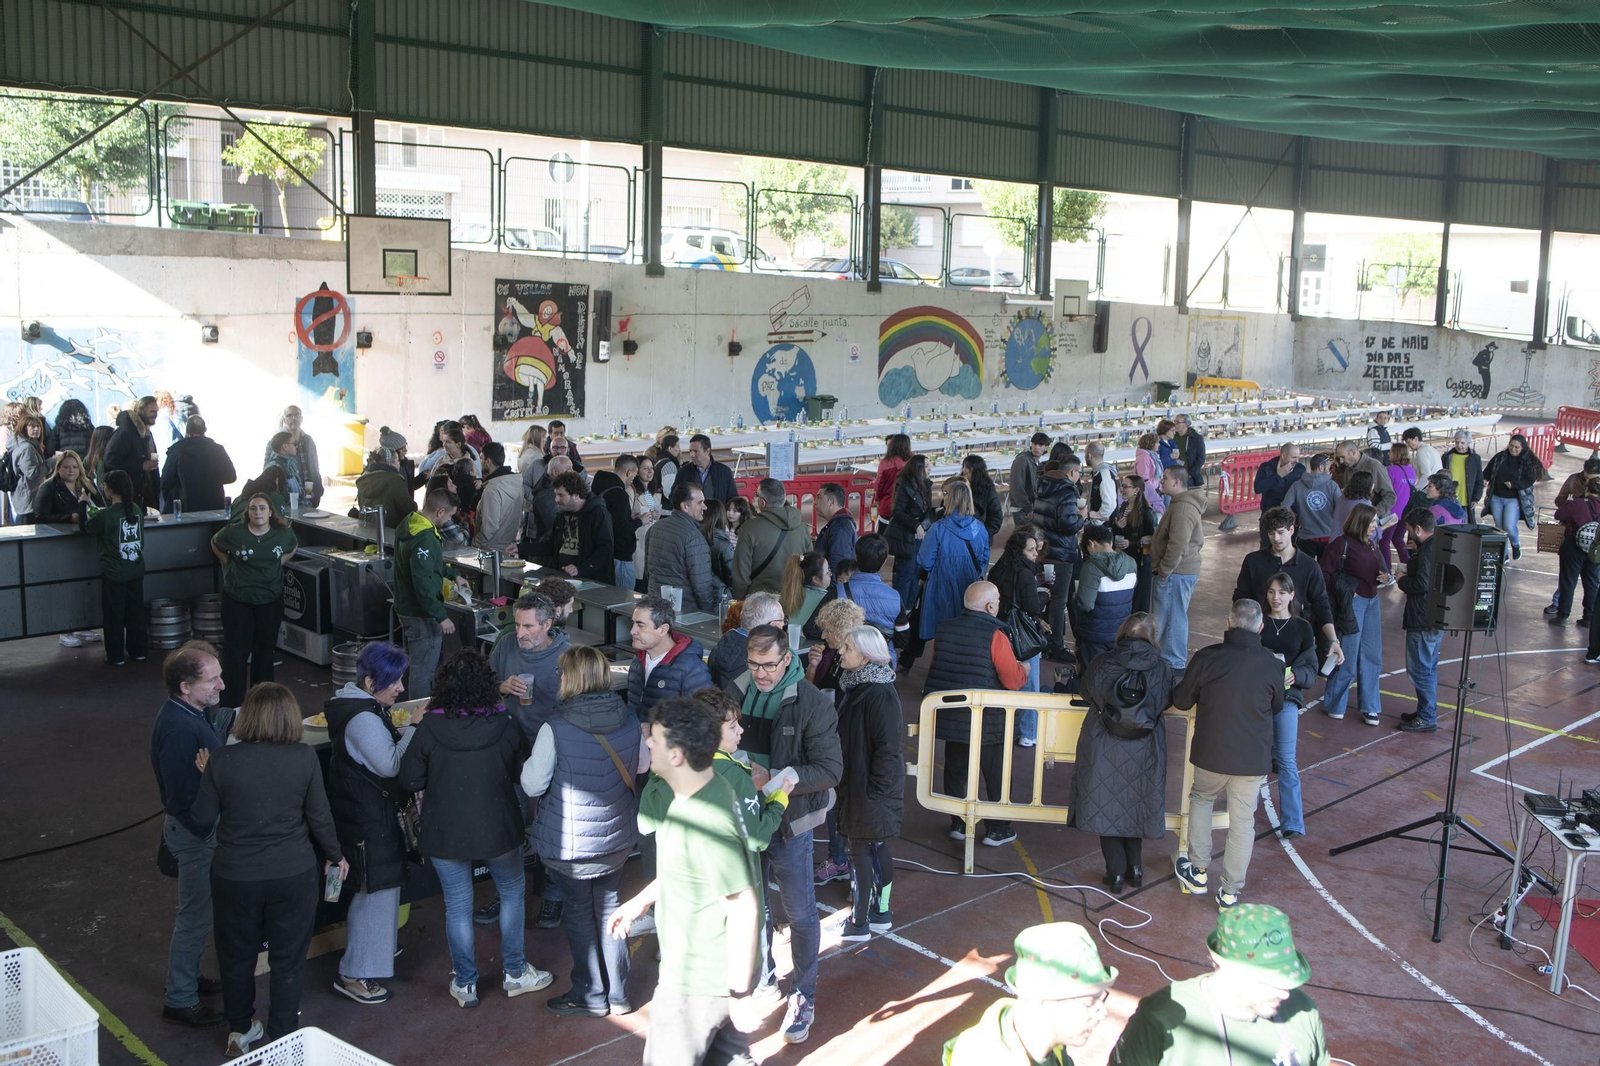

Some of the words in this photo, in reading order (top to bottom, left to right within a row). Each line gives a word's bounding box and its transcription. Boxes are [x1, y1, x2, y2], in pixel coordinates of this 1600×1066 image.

[497, 284, 510, 295] OS
[515, 284, 552, 295] VELLOS
[568, 285, 588, 297] NON
[1364, 336, 1376, 348] 17
[1381, 337, 1396, 349] DE
[1387, 352, 1411, 364] DAS
[1446, 377, 1484, 391] Castelao
[284, 585, 300, 599] strella
